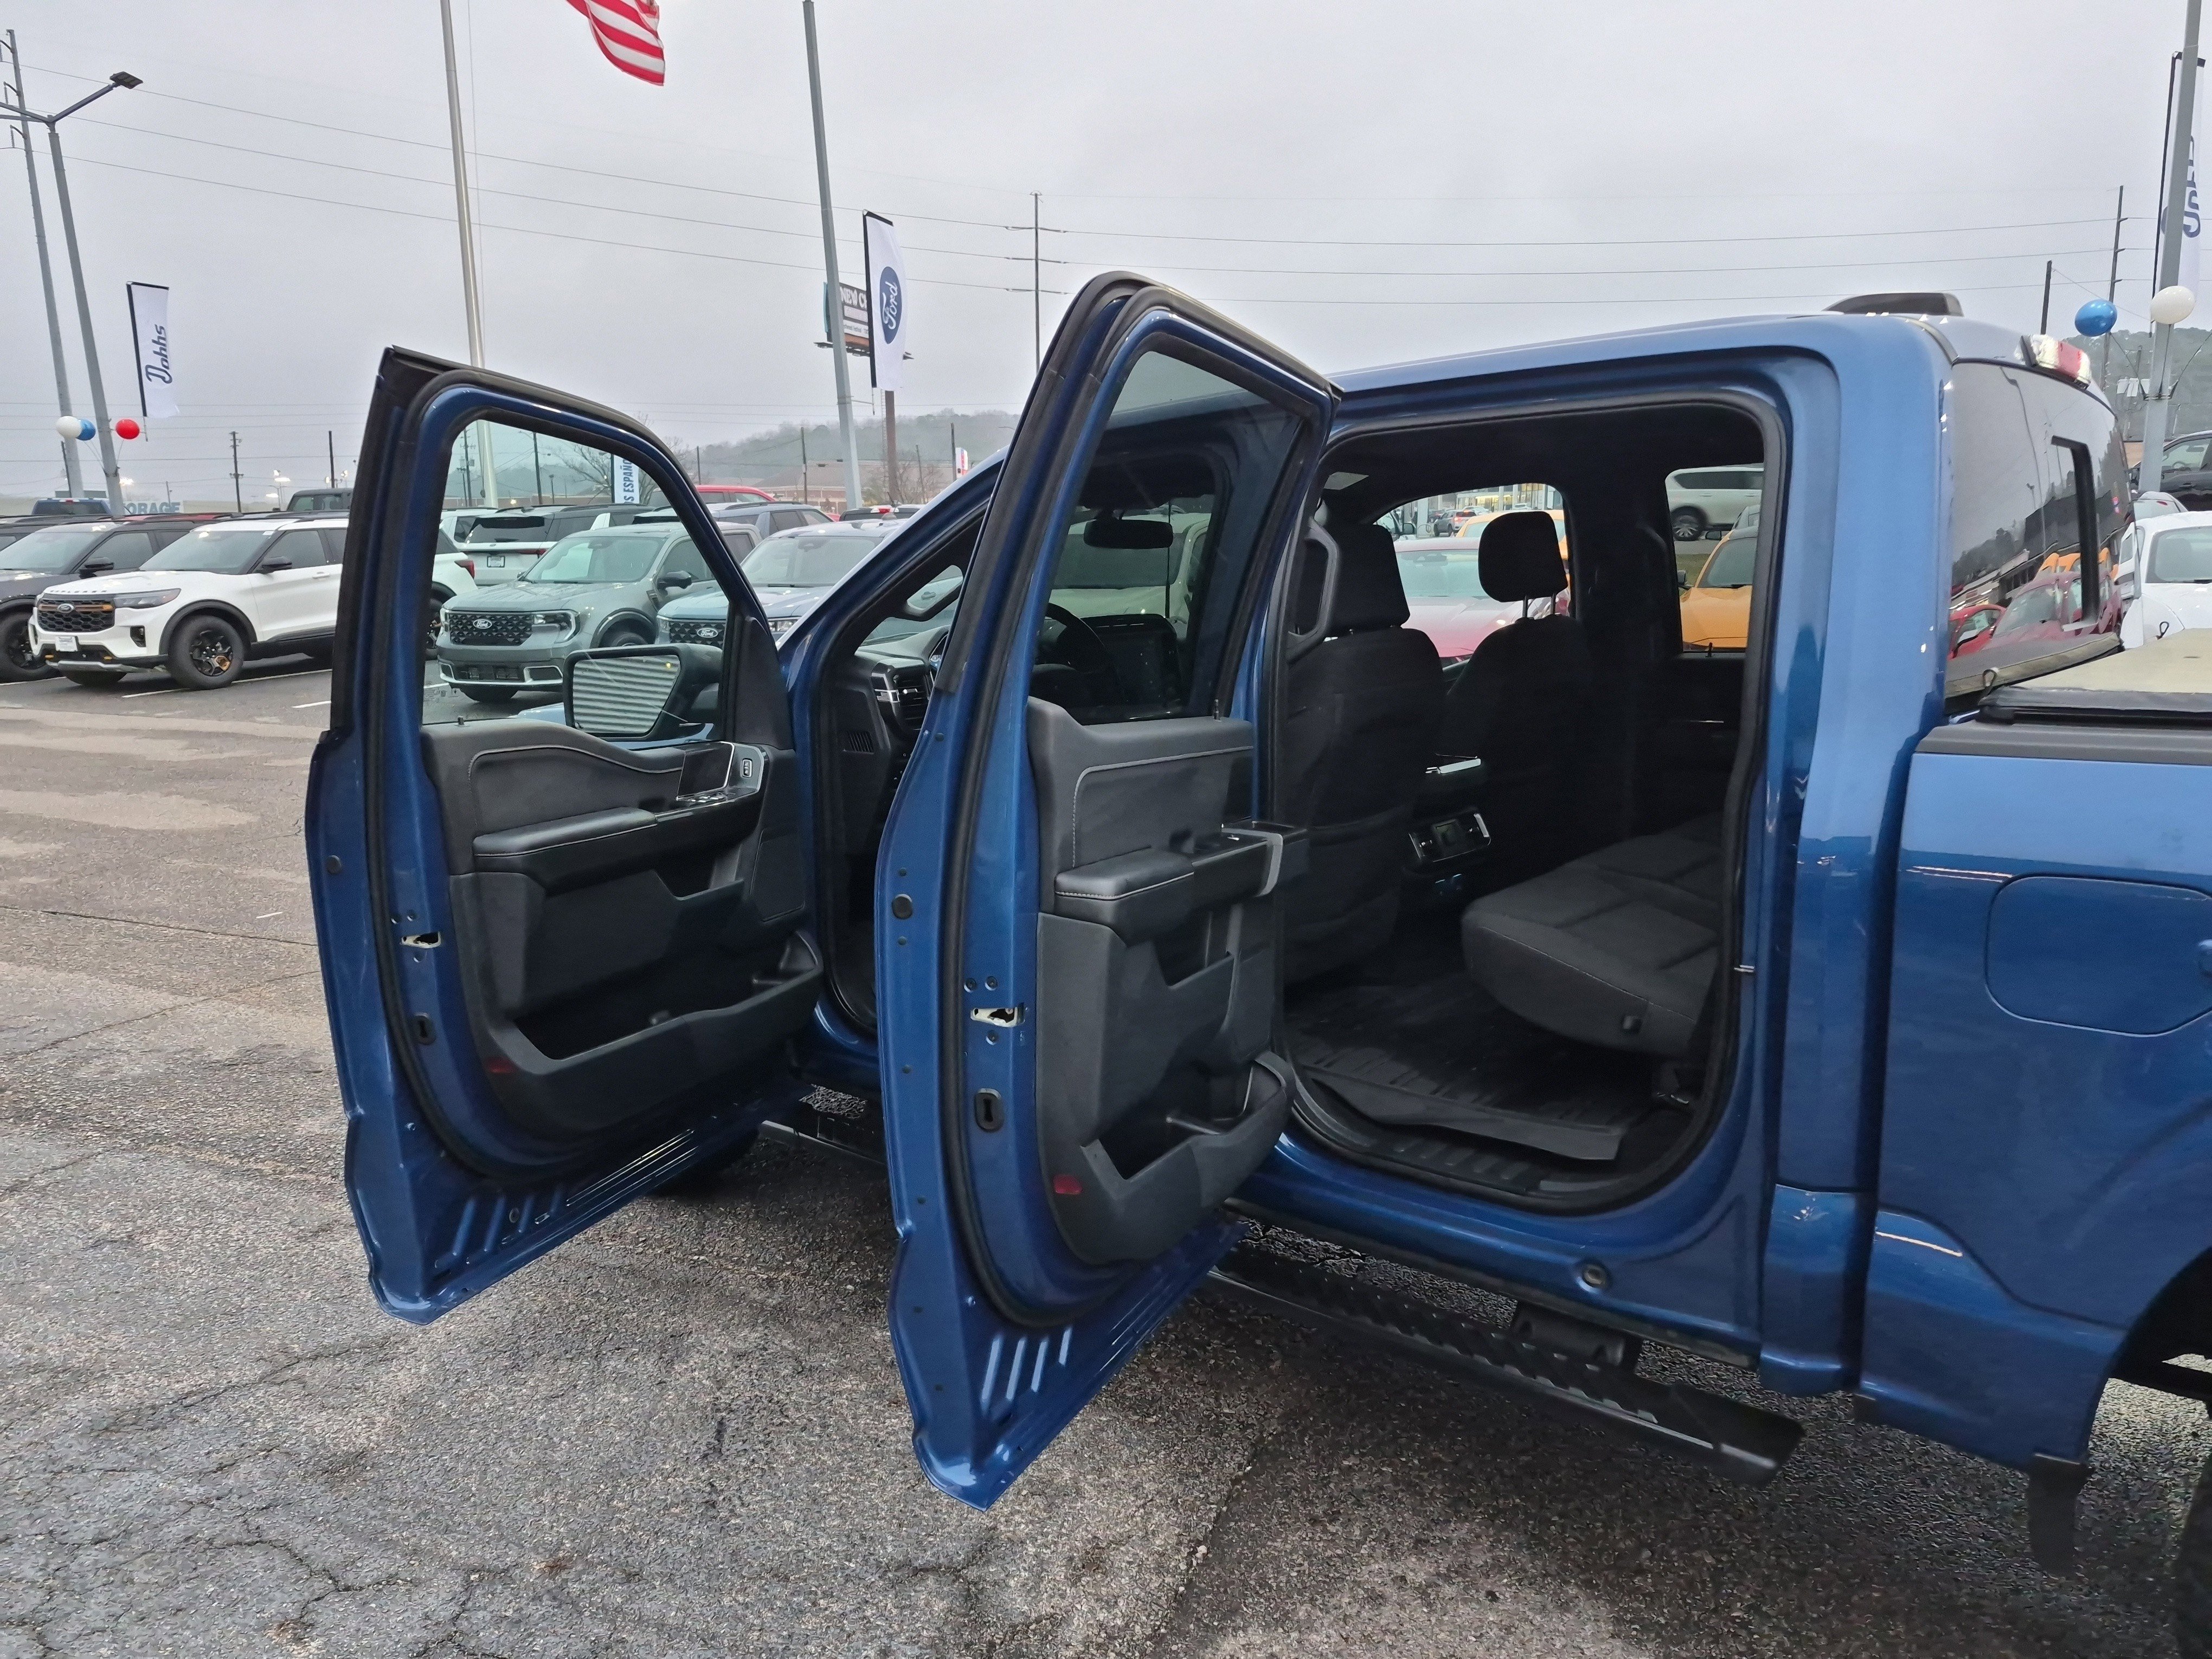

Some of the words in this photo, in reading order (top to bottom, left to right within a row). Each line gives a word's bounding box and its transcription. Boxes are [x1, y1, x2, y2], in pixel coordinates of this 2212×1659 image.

[839, 286, 858, 306] NEW
[882, 281, 898, 330] Ford
[620, 459, 635, 493] ESPAÑO
[125, 502, 181, 515] ORAGE
